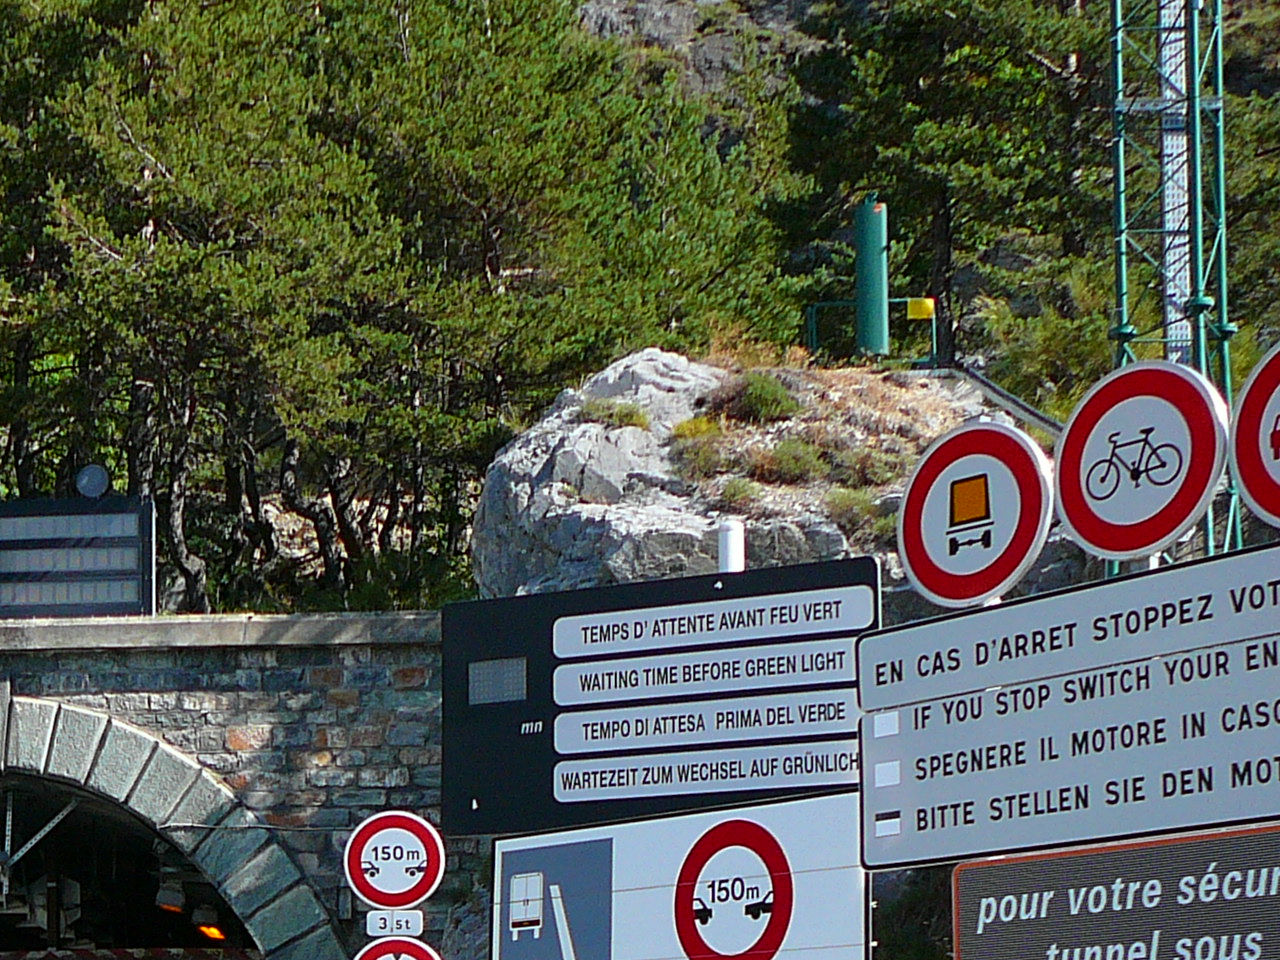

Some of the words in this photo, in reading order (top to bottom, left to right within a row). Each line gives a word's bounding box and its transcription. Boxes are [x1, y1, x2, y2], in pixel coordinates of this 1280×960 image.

[581, 622, 629, 644] TEMPS
[652, 614, 715, 638] ATTENTE
[719, 608, 766, 631] AVANT
[770, 605, 799, 625] FEU
[803, 600, 842, 622] VERT
[875, 659, 904, 686] EN
[917, 648, 961, 680] CAS
[975, 622, 1078, 667] D'ARRET
[1092, 594, 1214, 643] STOPPEZ
[580, 670, 639, 692] WAITING
[643, 666, 678, 686] TIME
[682, 660, 740, 683] BEFORE
[745, 655, 796, 677] GREEN
[801, 651, 846, 673] LIGHT
[914, 705, 932, 730] IF
[942, 696, 983, 725] YOU
[995, 684, 1051, 716] STOP
[1064, 666, 1151, 705] SWITCH
[1164, 651, 1230, 686] YOUR
[1246, 640, 1279, 671] EN
[520, 720, 544, 735] mn
[582, 719, 631, 741] TEMPO
[635, 718, 649, 736] DI
[652, 713, 705, 735] ATTESA
[716, 709, 762, 730] PRIMA
[766, 706, 794, 726] DEL
[798, 702, 845, 723] VERDE
[915, 741, 1027, 781] SPEGNERE
[1039, 736, 1059, 762] IL
[1071, 717, 1167, 758] MOTORE
[1182, 711, 1206, 739] IN
[561, 768, 638, 791] WARTEZEIT
[642, 765, 672, 785] ZUM
[677, 760, 746, 782] WECHSEL
[750, 758, 779, 777] AUF
[916, 801, 975, 832] BITTE
[989, 784, 1089, 822] STELLEN
[1105, 777, 1146, 806] SIE
[1162, 766, 1213, 798] DEN
[977, 890, 1054, 934] pour
[1069, 878, 1162, 916] votre
